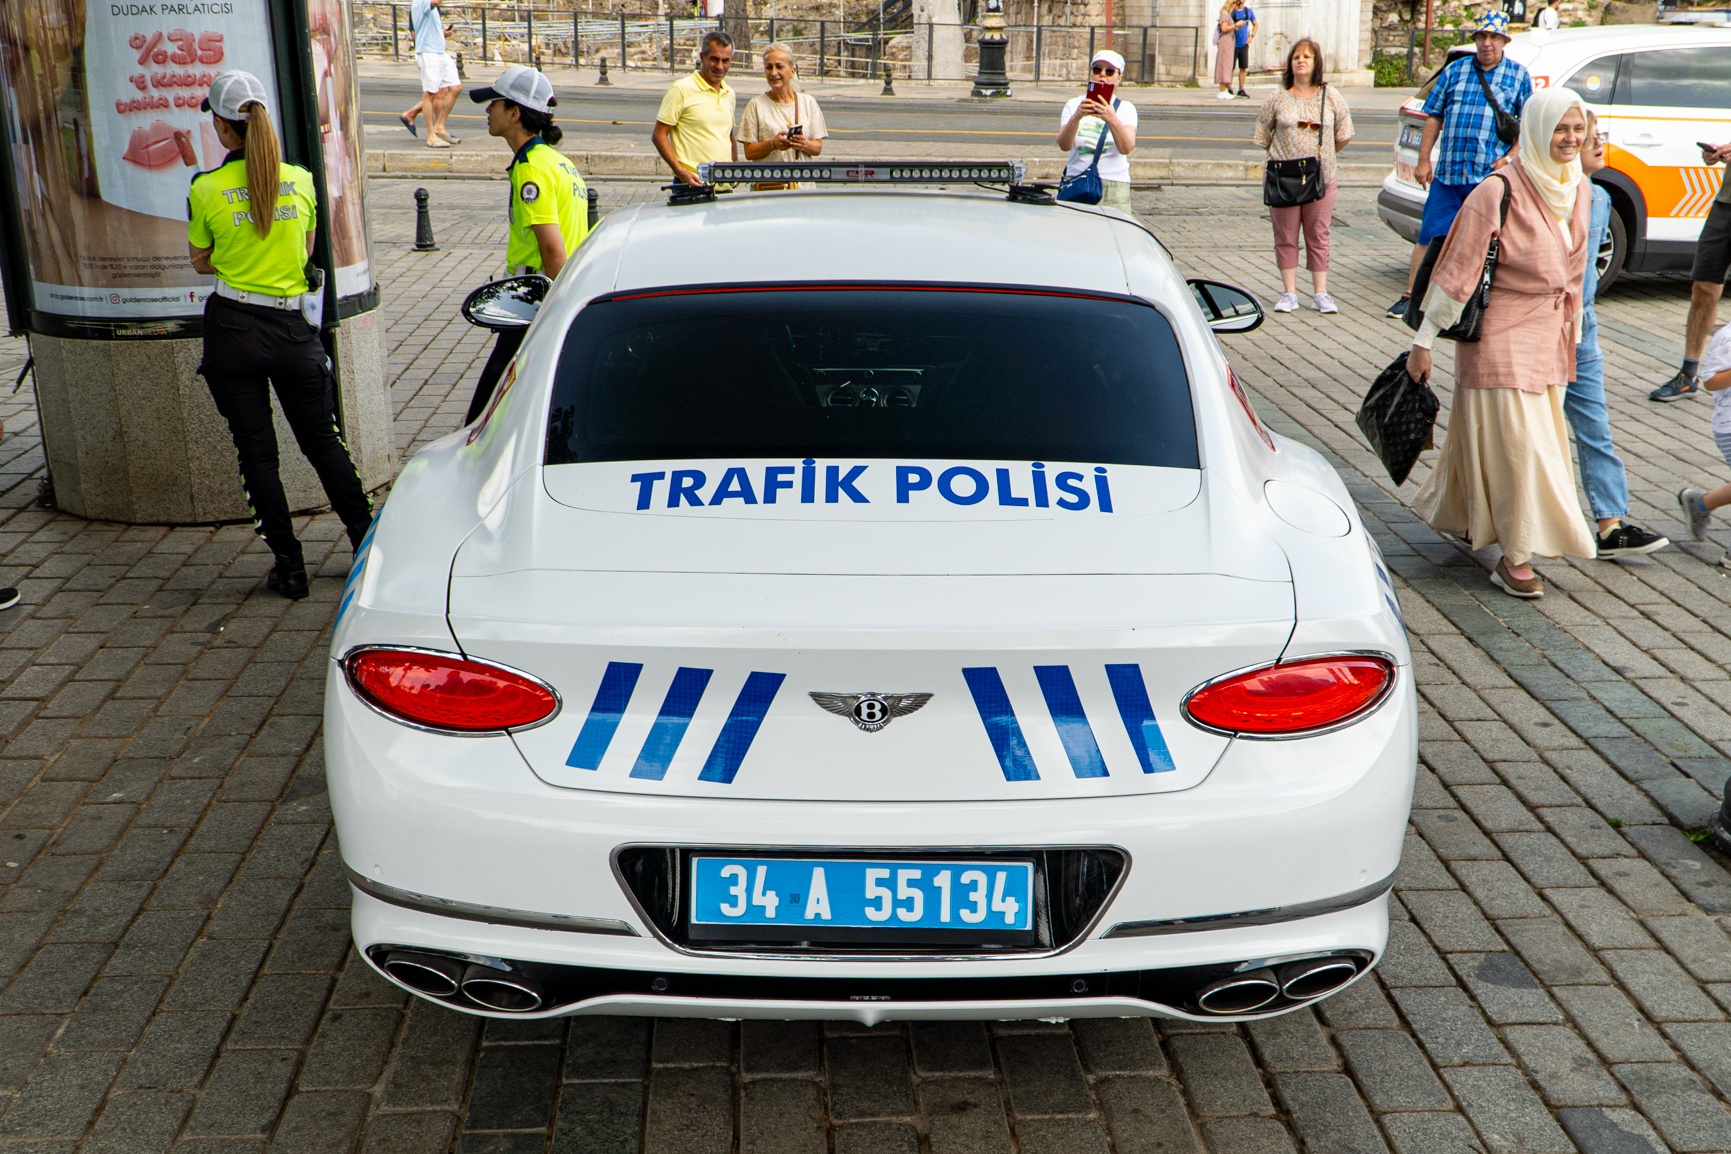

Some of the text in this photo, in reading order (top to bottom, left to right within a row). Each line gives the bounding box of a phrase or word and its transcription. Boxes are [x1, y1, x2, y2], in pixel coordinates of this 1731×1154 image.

[111, 3, 233, 16] DUDAK PARLATICISI
[128, 28, 225, 65] %35
[150, 70, 219, 88] KADA
[115, 95, 170, 114] DAHA
[630, 458, 1114, 513] TRAFİK POLİSİ
[720, 865, 1020, 924] 34 A 55134
